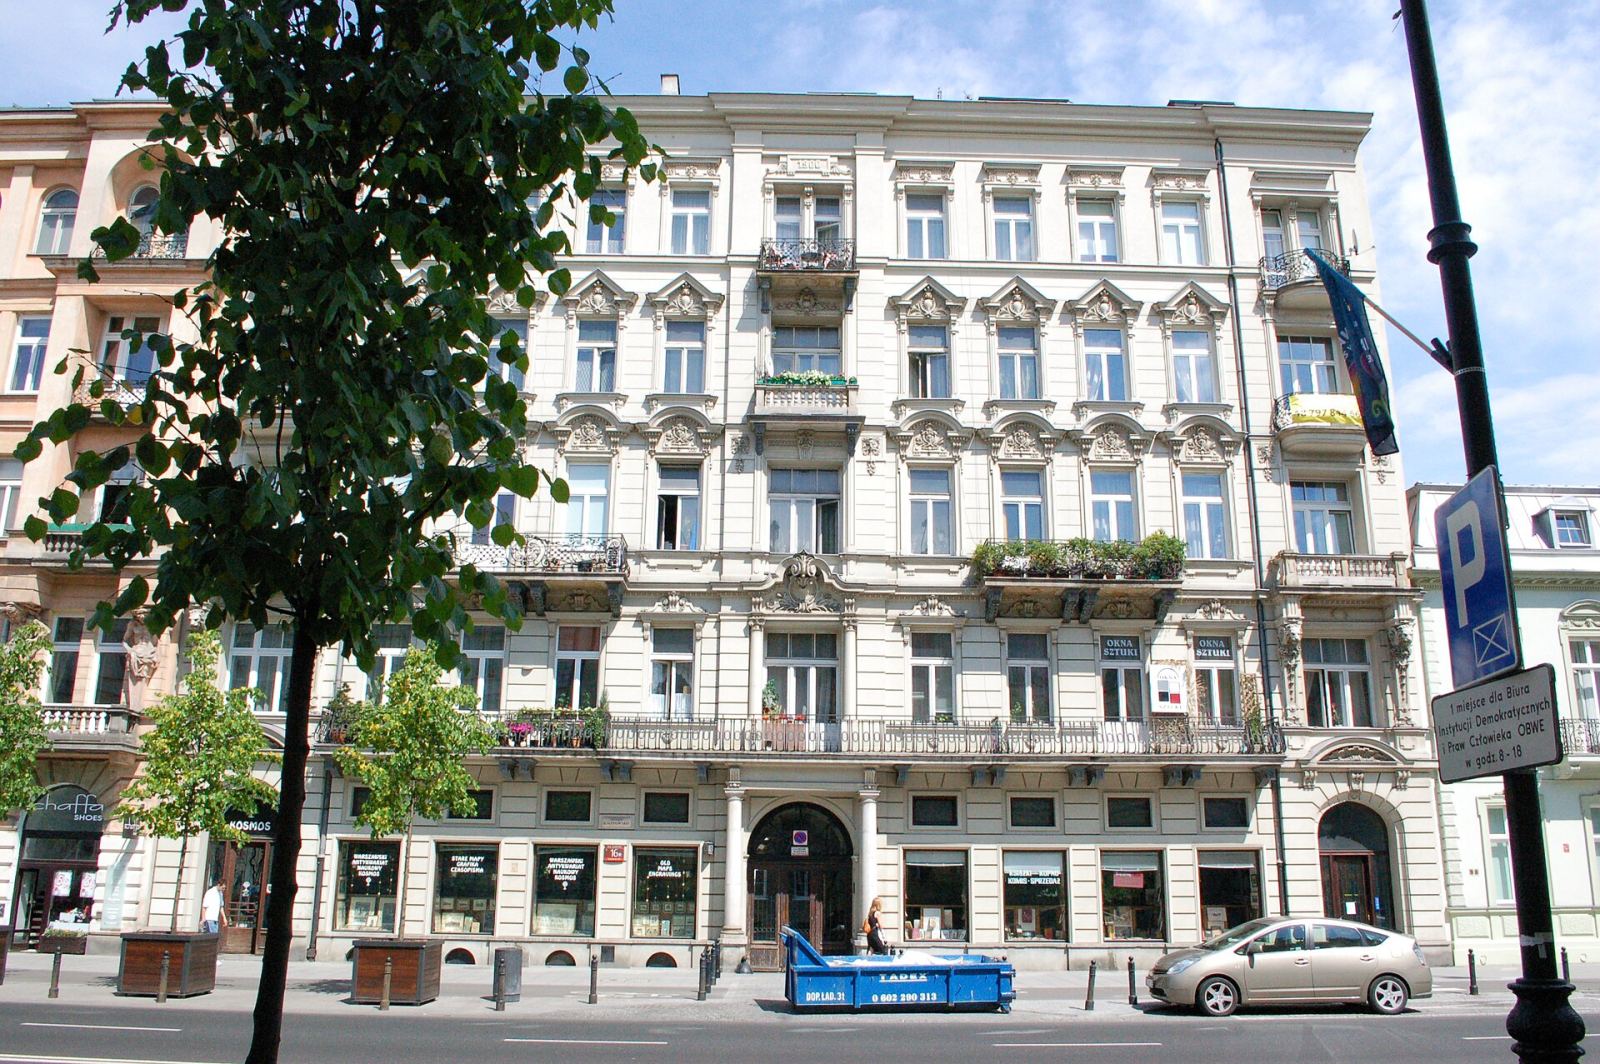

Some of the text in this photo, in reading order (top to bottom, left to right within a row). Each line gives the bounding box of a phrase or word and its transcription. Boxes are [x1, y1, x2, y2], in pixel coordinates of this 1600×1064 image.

[1446, 500, 1486, 629] P
[1106, 639, 1133, 647] OKNA
[1199, 639, 1225, 648] OKNA
[1103, 648, 1138, 656] SZTUKI
[1196, 648, 1231, 657] SZTUKI
[1450, 685, 1530, 715] 1 miejsce dla Biura
[1438, 697, 1550, 737] Instytucji Demokratycznych
[1448, 741, 1465, 754] Praw
[1469, 728, 1512, 747] Człowieka
[1517, 719, 1545, 737] OBWE
[1465, 760, 1471, 768] w
[1476, 752, 1498, 769] godz.
[1512, 745, 1522, 758] 18
[73, 814, 103, 822] SHOES
[229, 820, 271, 831] KOSMOS
[872, 994, 879, 1002] 0
[880, 993, 898, 1002] 602
[920, 992, 937, 1001] 313
